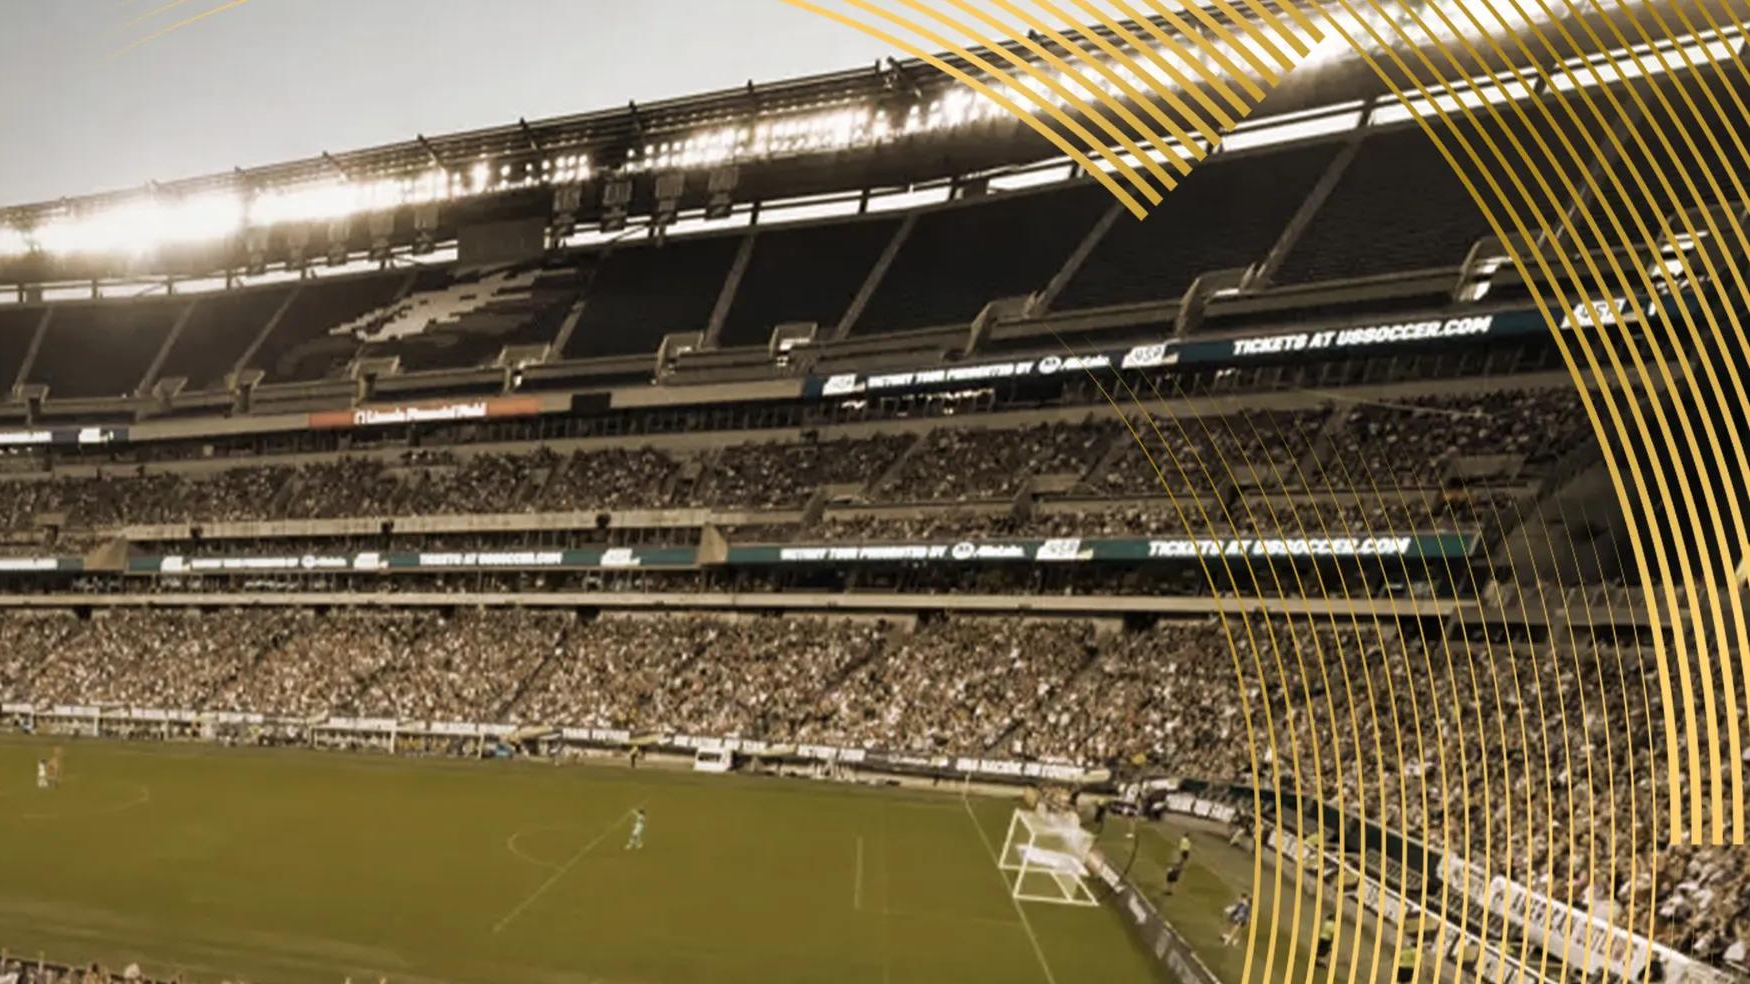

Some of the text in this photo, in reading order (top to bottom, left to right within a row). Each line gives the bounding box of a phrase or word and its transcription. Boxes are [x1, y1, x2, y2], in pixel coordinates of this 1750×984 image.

[1233, 316, 1493, 355] TICKETS AT USSOCCER.COM
[1148, 540, 1224, 556] TICKETS
[1225, 540, 1251, 555] AT
